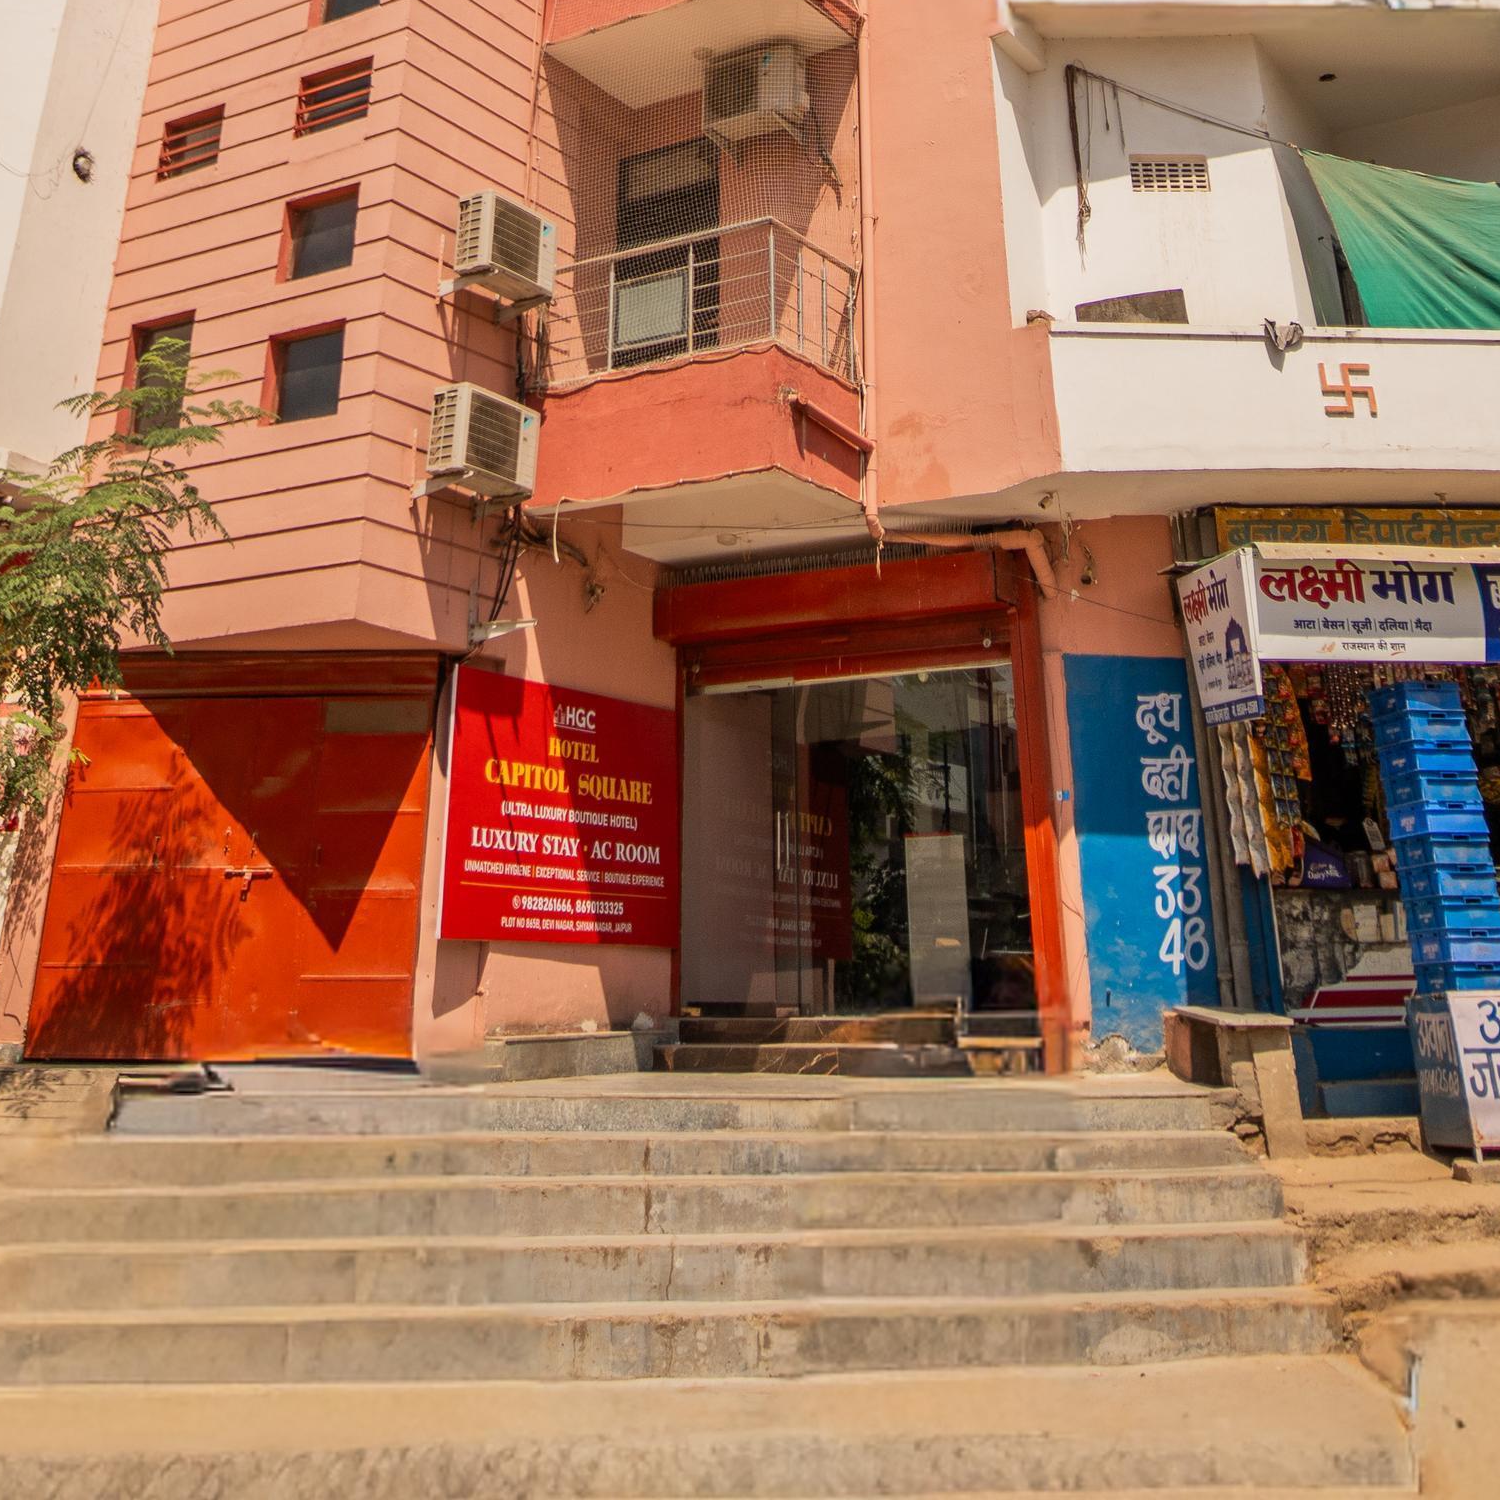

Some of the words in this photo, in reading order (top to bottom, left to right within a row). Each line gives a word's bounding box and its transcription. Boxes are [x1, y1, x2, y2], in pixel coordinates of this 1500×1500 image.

[1259, 559, 1367, 610] लक्ष्मी
[1370, 560, 1455, 605] भोग
[1293, 618, 1316, 631] आटा
[1322, 617, 1346, 631] बेसन
[1350, 617, 1373, 633] सूजी
[1378, 617, 1409, 632] दलिया
[1414, 617, 1433, 632] मैदा
[1341, 642, 1377, 653] राजस्थान
[1377, 640, 1388, 652] की
[566, 705, 596, 729] HGC
[1135, 692, 1182, 744] दूध
[548, 736, 599, 763] HOTEL
[485, 757, 569, 794] CAPITOL
[578, 773, 653, 805] SQUARE
[1140, 744, 1195, 801] दही
[501, 800, 533, 818] (ULTRA
[534, 804, 567, 822] LUXURY
[568, 809, 608, 827] BOUTIQUE
[609, 813, 638, 831] HOTEL)
[471, 826, 540, 854] LUXURY
[542, 834, 581, 858] STAY
[590, 841, 612, 861] AC
[615, 843, 661, 865] ROOM
[464, 859, 504, 875] UNMATCHED
[504, 862, 531, 877] HYGIENE
[536, 864, 575, 881] EXCEPTIONAL
[576, 869, 601, 882] SERVICE
[604, 872, 631, 885] BOUTIQUE
[1152, 865, 1202, 919] 33
[1159, 917, 1209, 975] 48
